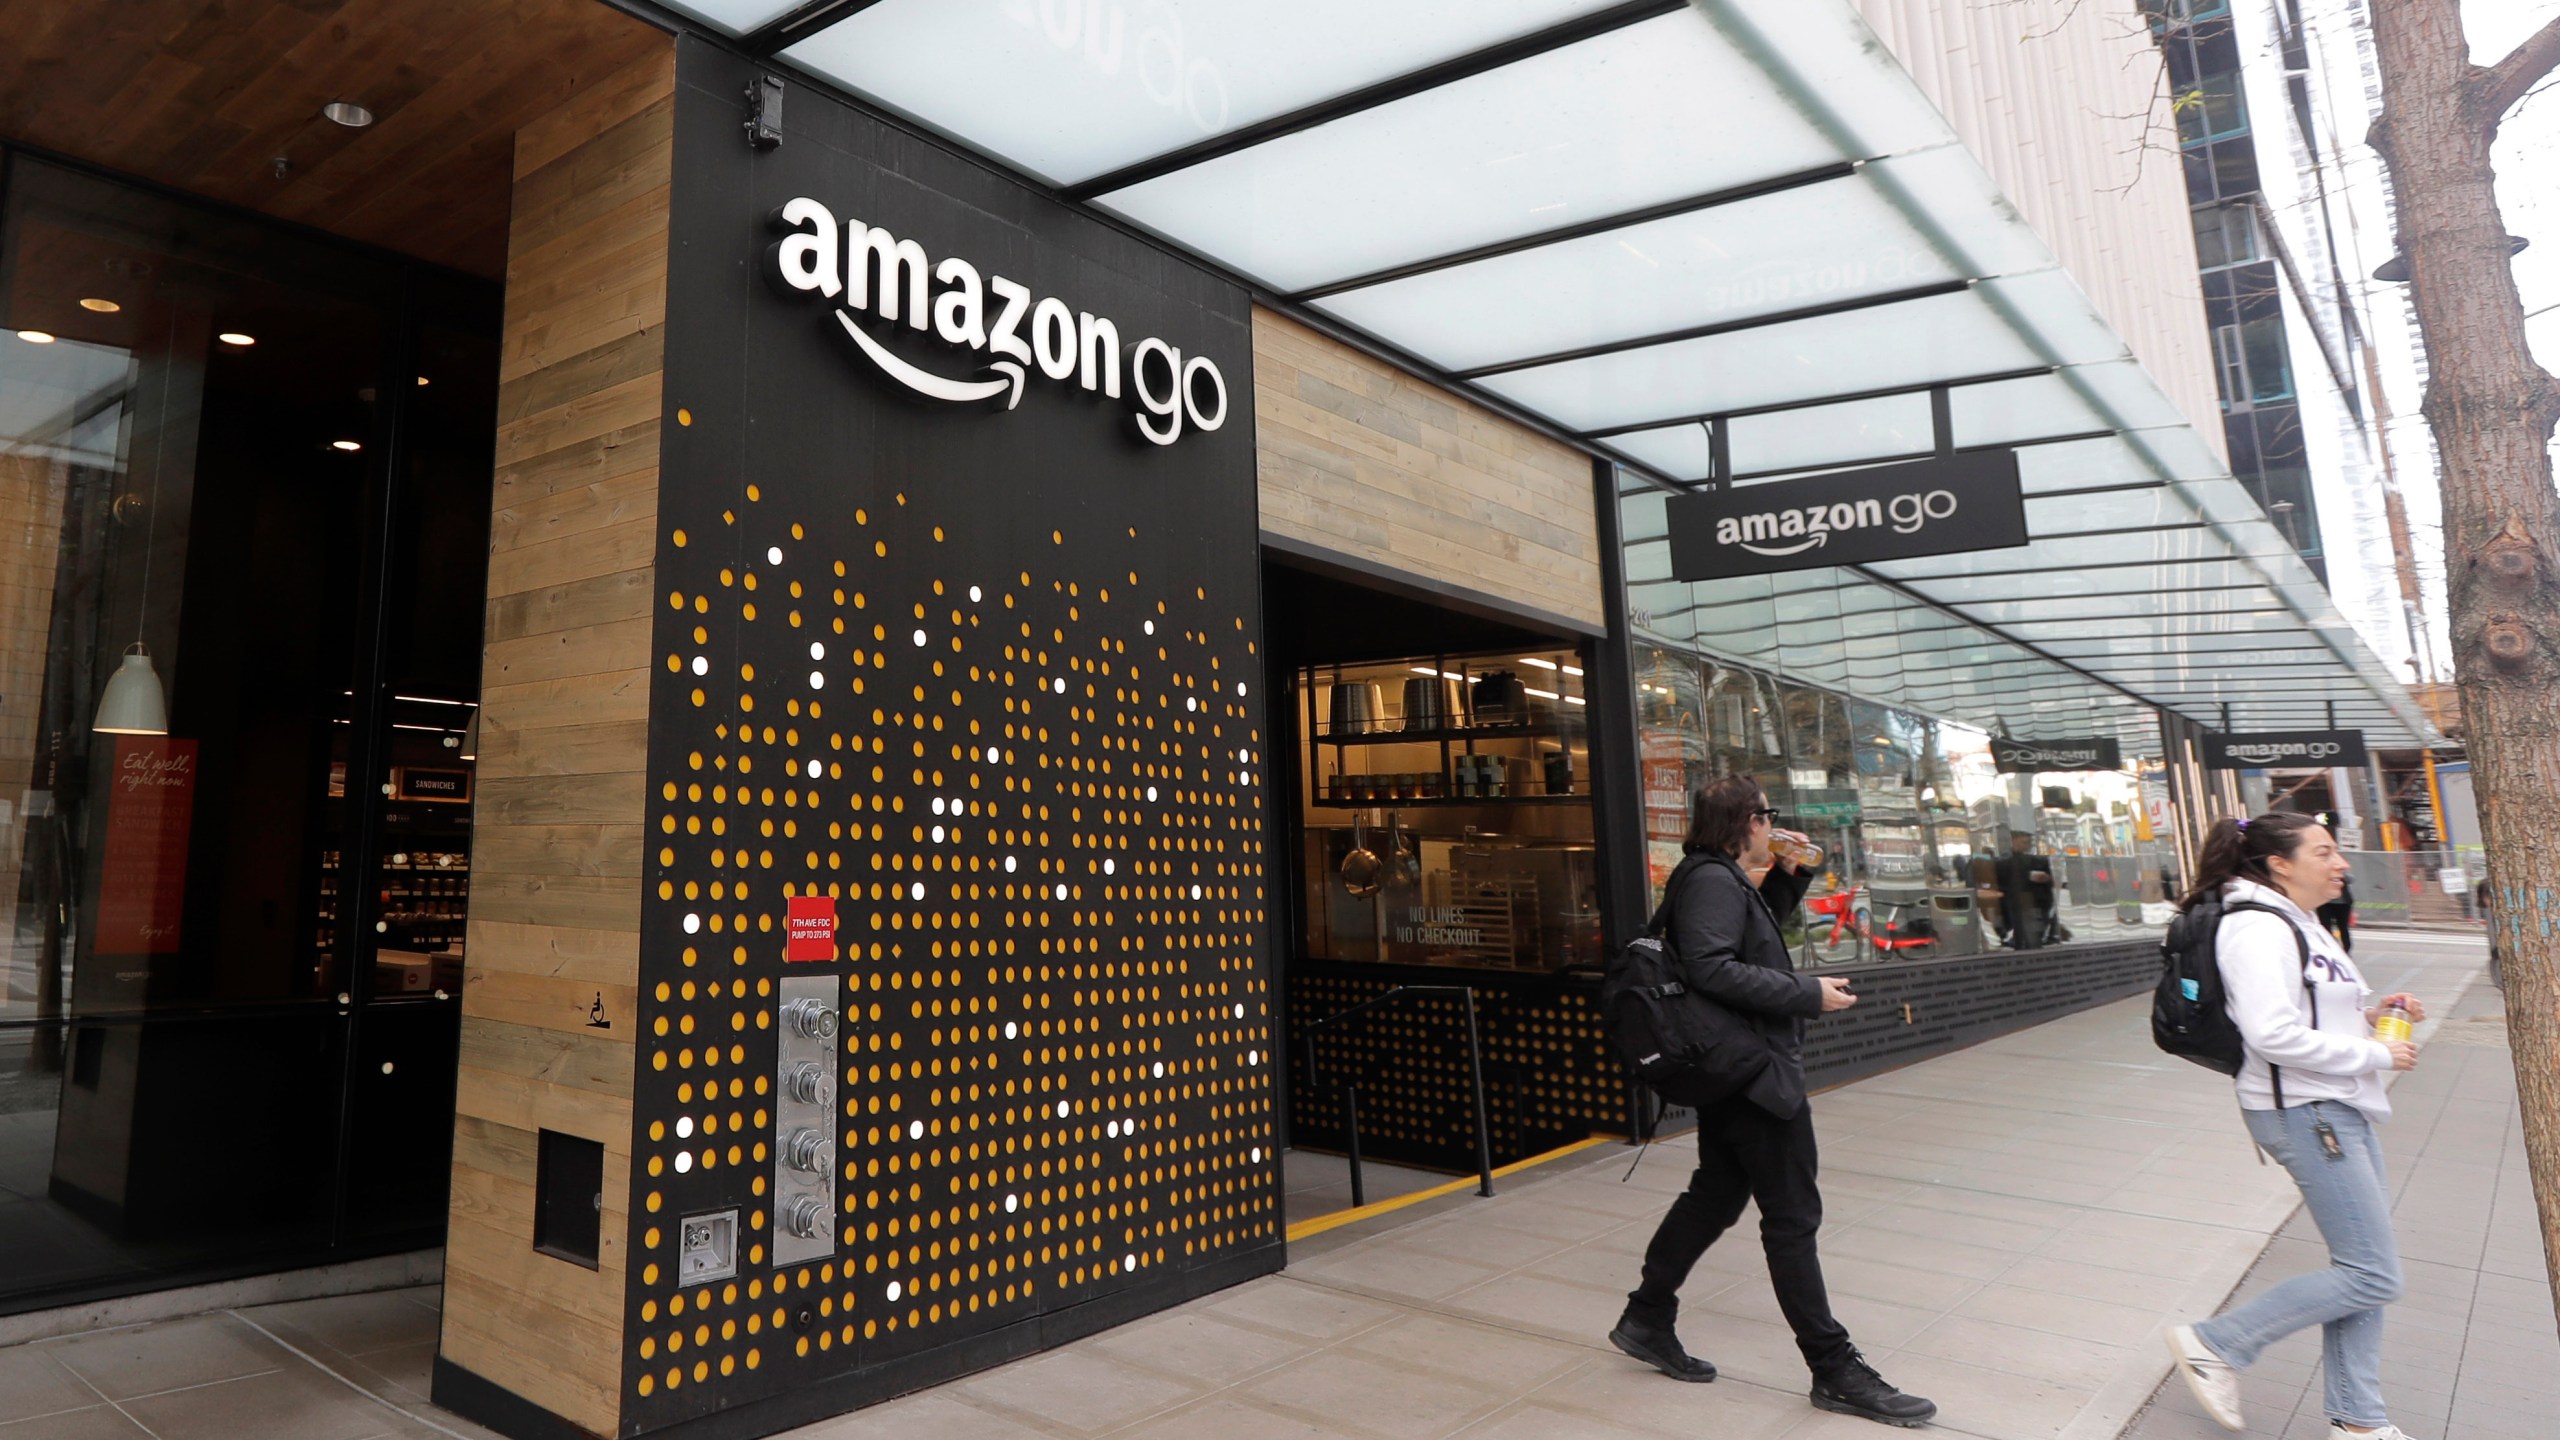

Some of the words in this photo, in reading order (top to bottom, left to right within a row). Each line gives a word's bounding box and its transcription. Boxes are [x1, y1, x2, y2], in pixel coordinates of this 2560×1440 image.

[778, 197, 1121, 399] amazon
[1132, 335, 1228, 446] go
[1716, 498, 1883, 546] amazon
[1888, 489, 1957, 534] go
[2225, 742, 2307, 757] amazon
[2307, 742, 2341, 759] go
[122, 750, 155, 770] Eat
[154, 753, 190, 774] well,
[119, 768, 158, 792] right
[157, 775, 187, 788] now.
[415, 779, 456, 790] SANDWICHES
[1658, 813, 1681, 833] OUT
[1409, 906, 1426, 922] NO
[792, 919, 804, 927] 7TH
[805, 919, 817, 927] AVE
[818, 919, 830, 927] FDC
[792, 931, 806, 939] PUMP
[806, 931, 814, 939] TO
[814, 931, 822, 939] 273
[1397, 926, 1413, 943] NO
